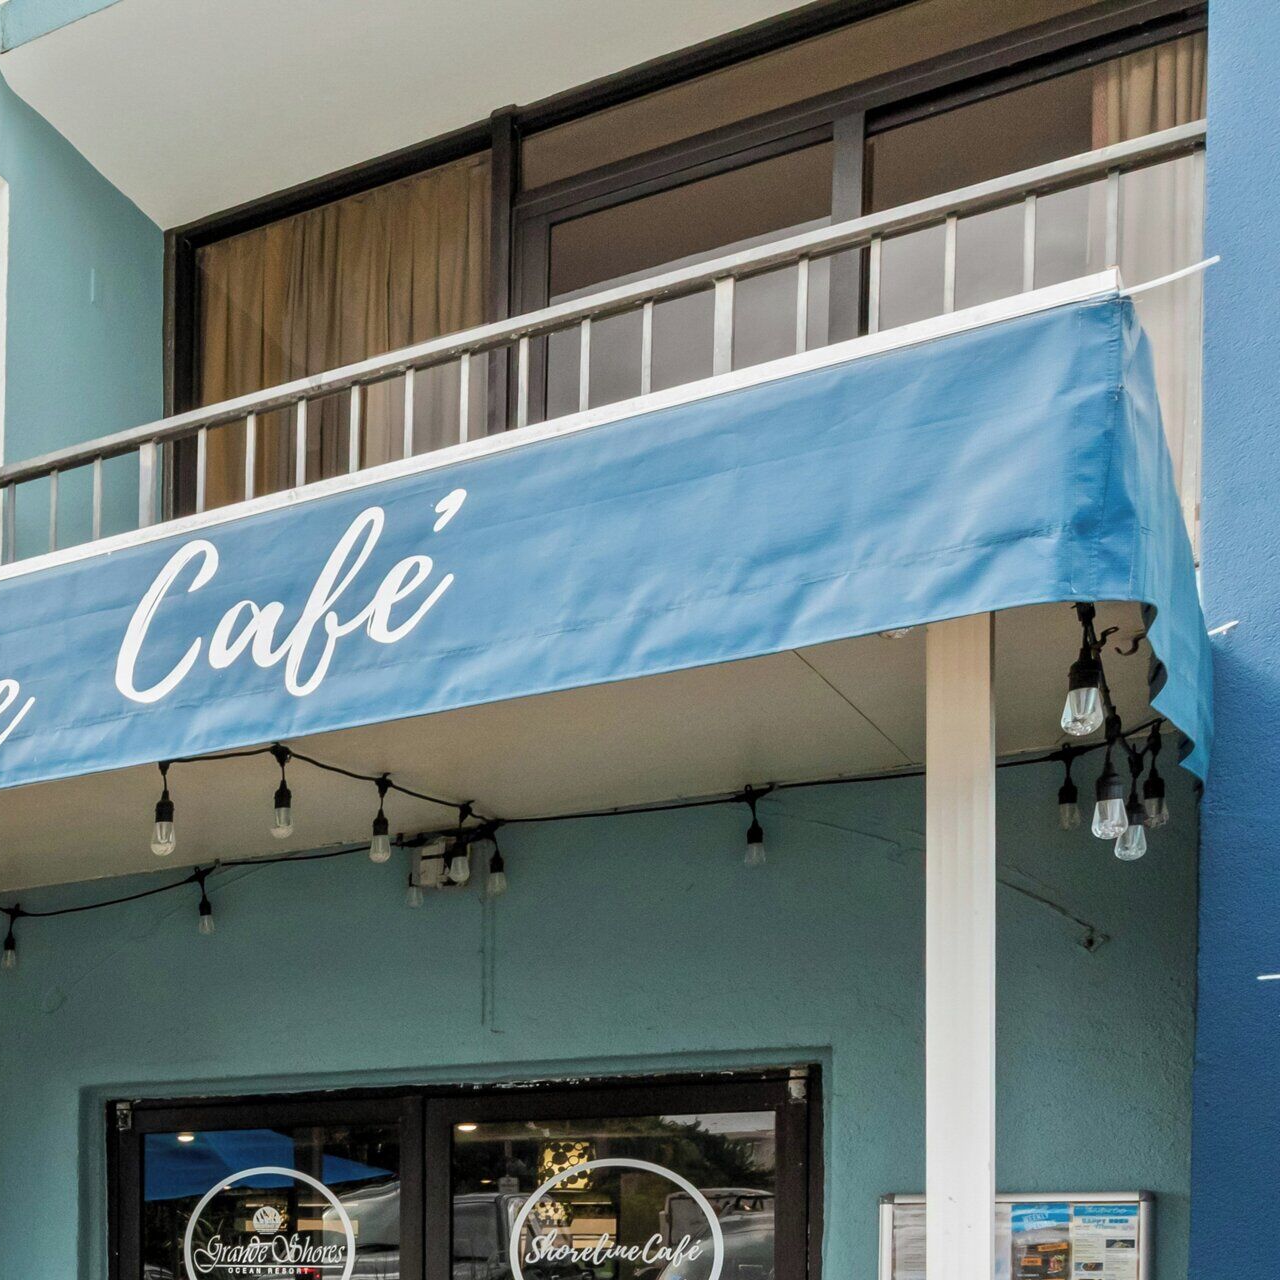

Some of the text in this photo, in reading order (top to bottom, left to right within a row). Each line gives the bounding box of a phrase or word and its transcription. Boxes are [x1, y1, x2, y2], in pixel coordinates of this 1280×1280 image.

[114, 488, 468, 704] Café
[193, 1232, 345, 1273] Grande Shores
[525, 1229, 704, 1267] Shoreline Café
[227, 1267, 310, 1276] OCEAN RESORT
